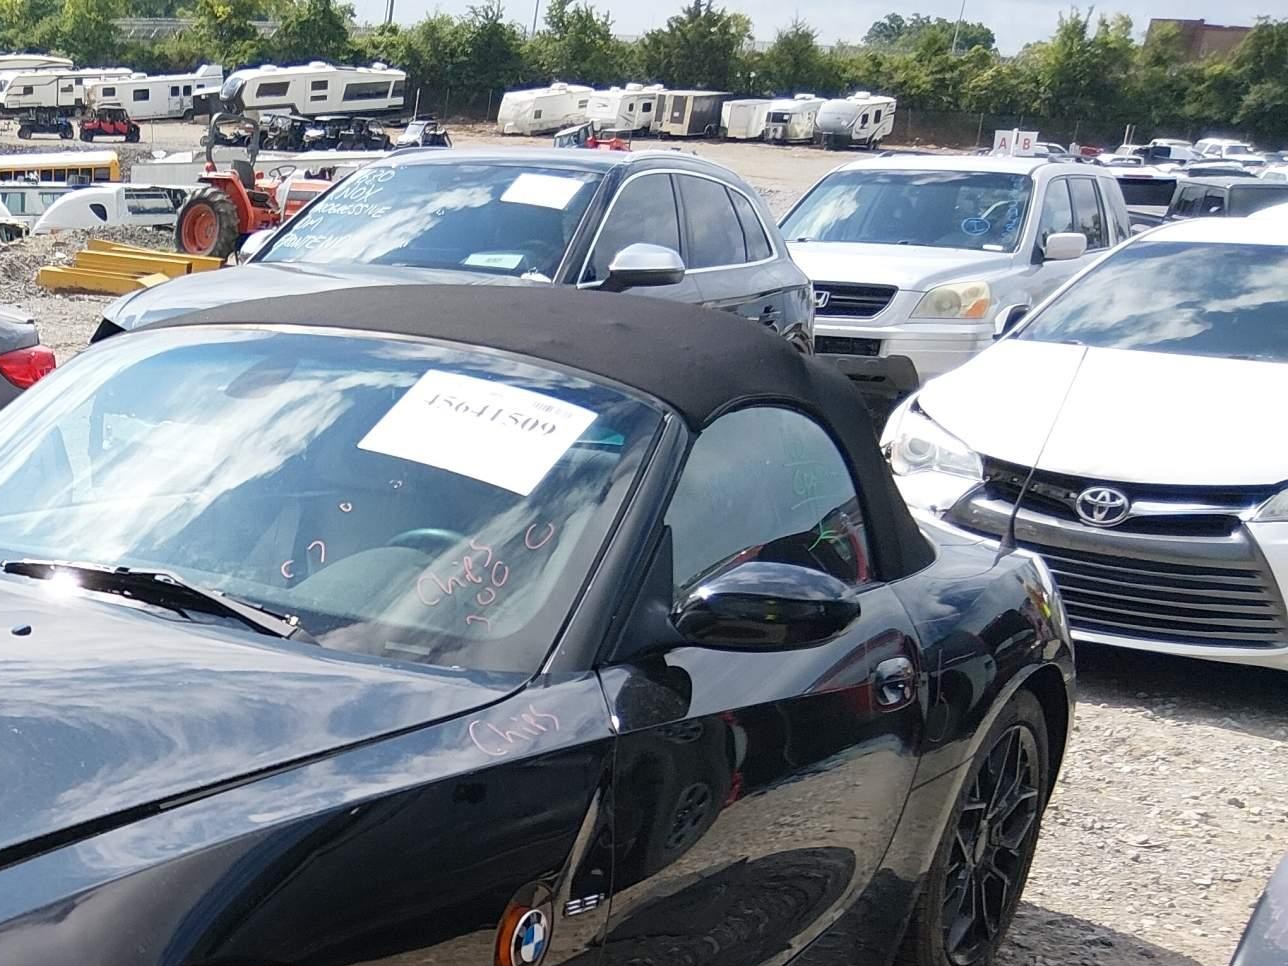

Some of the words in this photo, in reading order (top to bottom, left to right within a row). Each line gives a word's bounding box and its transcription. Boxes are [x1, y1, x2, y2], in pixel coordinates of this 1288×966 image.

[998, 137, 1008, 150] A
[1022, 138, 1031, 151] B
[425, 393, 557, 436] 45641509
